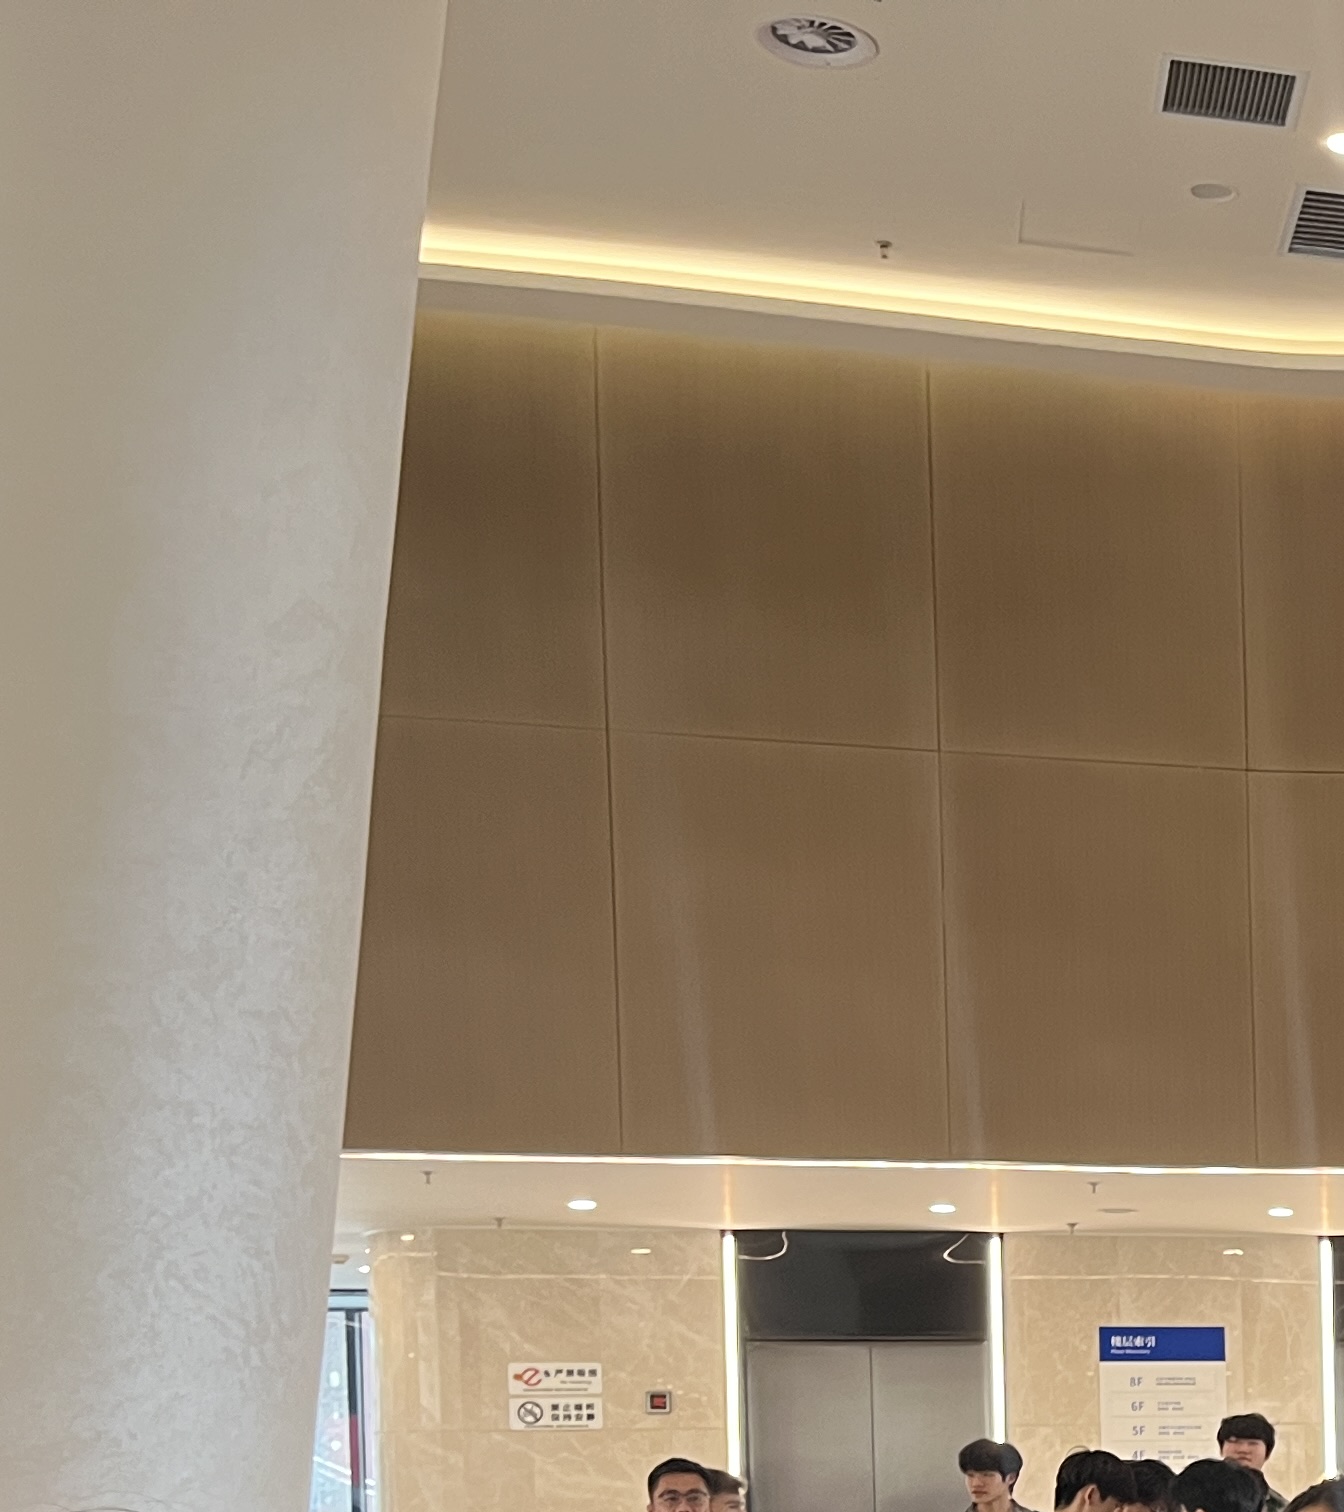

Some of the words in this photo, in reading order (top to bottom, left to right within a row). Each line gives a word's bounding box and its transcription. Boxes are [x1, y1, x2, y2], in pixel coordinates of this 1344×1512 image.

[1129, 1376, 1143, 1388] 8F
[1131, 1401, 1145, 1412] 6F
[1132, 1425, 1146, 1436] 5F
